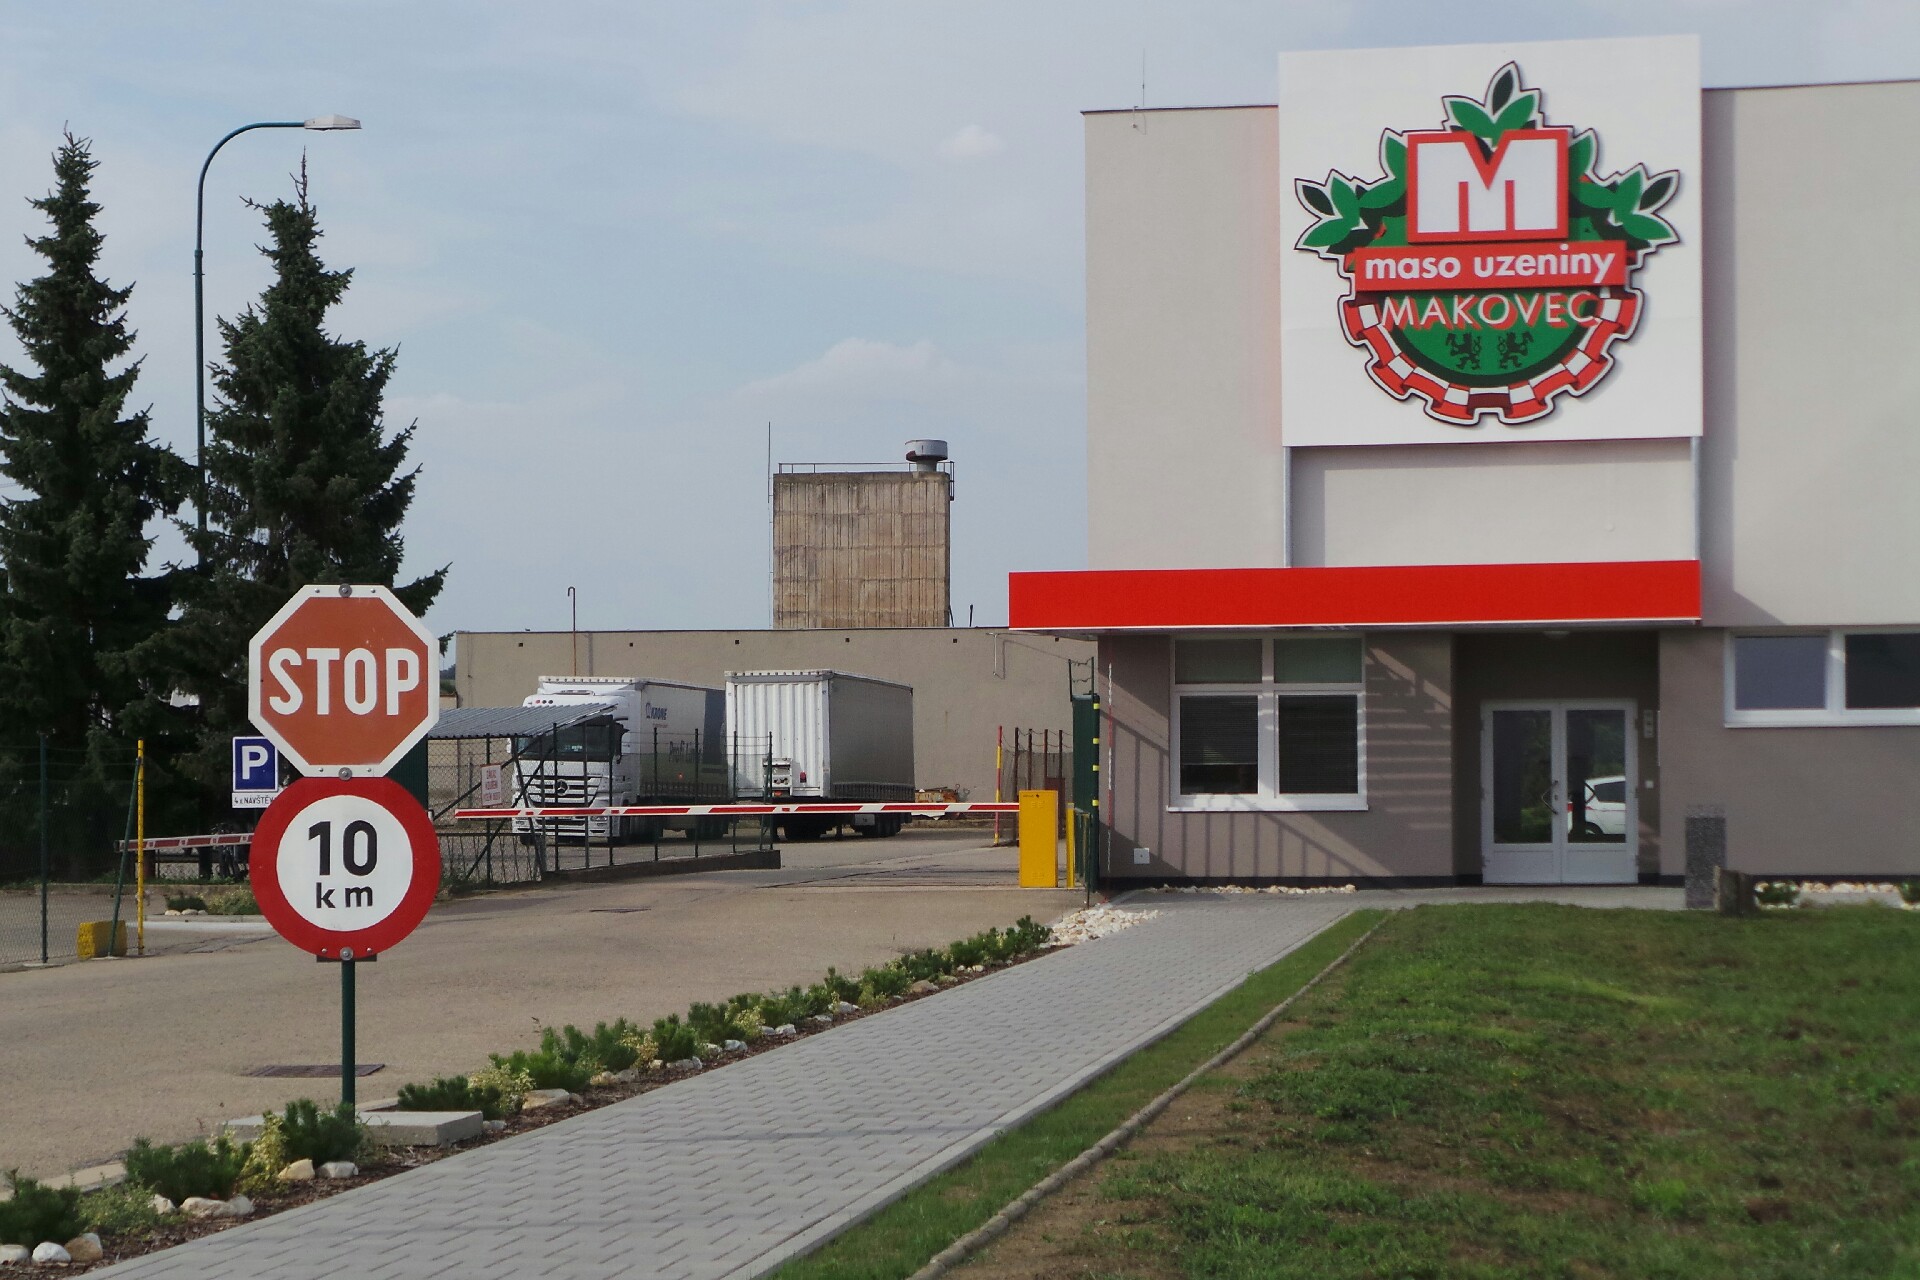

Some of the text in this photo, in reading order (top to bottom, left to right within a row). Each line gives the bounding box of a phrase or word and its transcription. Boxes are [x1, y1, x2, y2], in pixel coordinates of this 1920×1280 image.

[1417, 139, 1558, 234] M
[1365, 243, 1616, 284] maso uzeniny
[1381, 291, 1600, 331] MAKOVEC
[268, 647, 420, 716] STOP
[241, 745, 269, 780] P
[308, 820, 378, 876] 10
[316, 882, 373, 908] km
